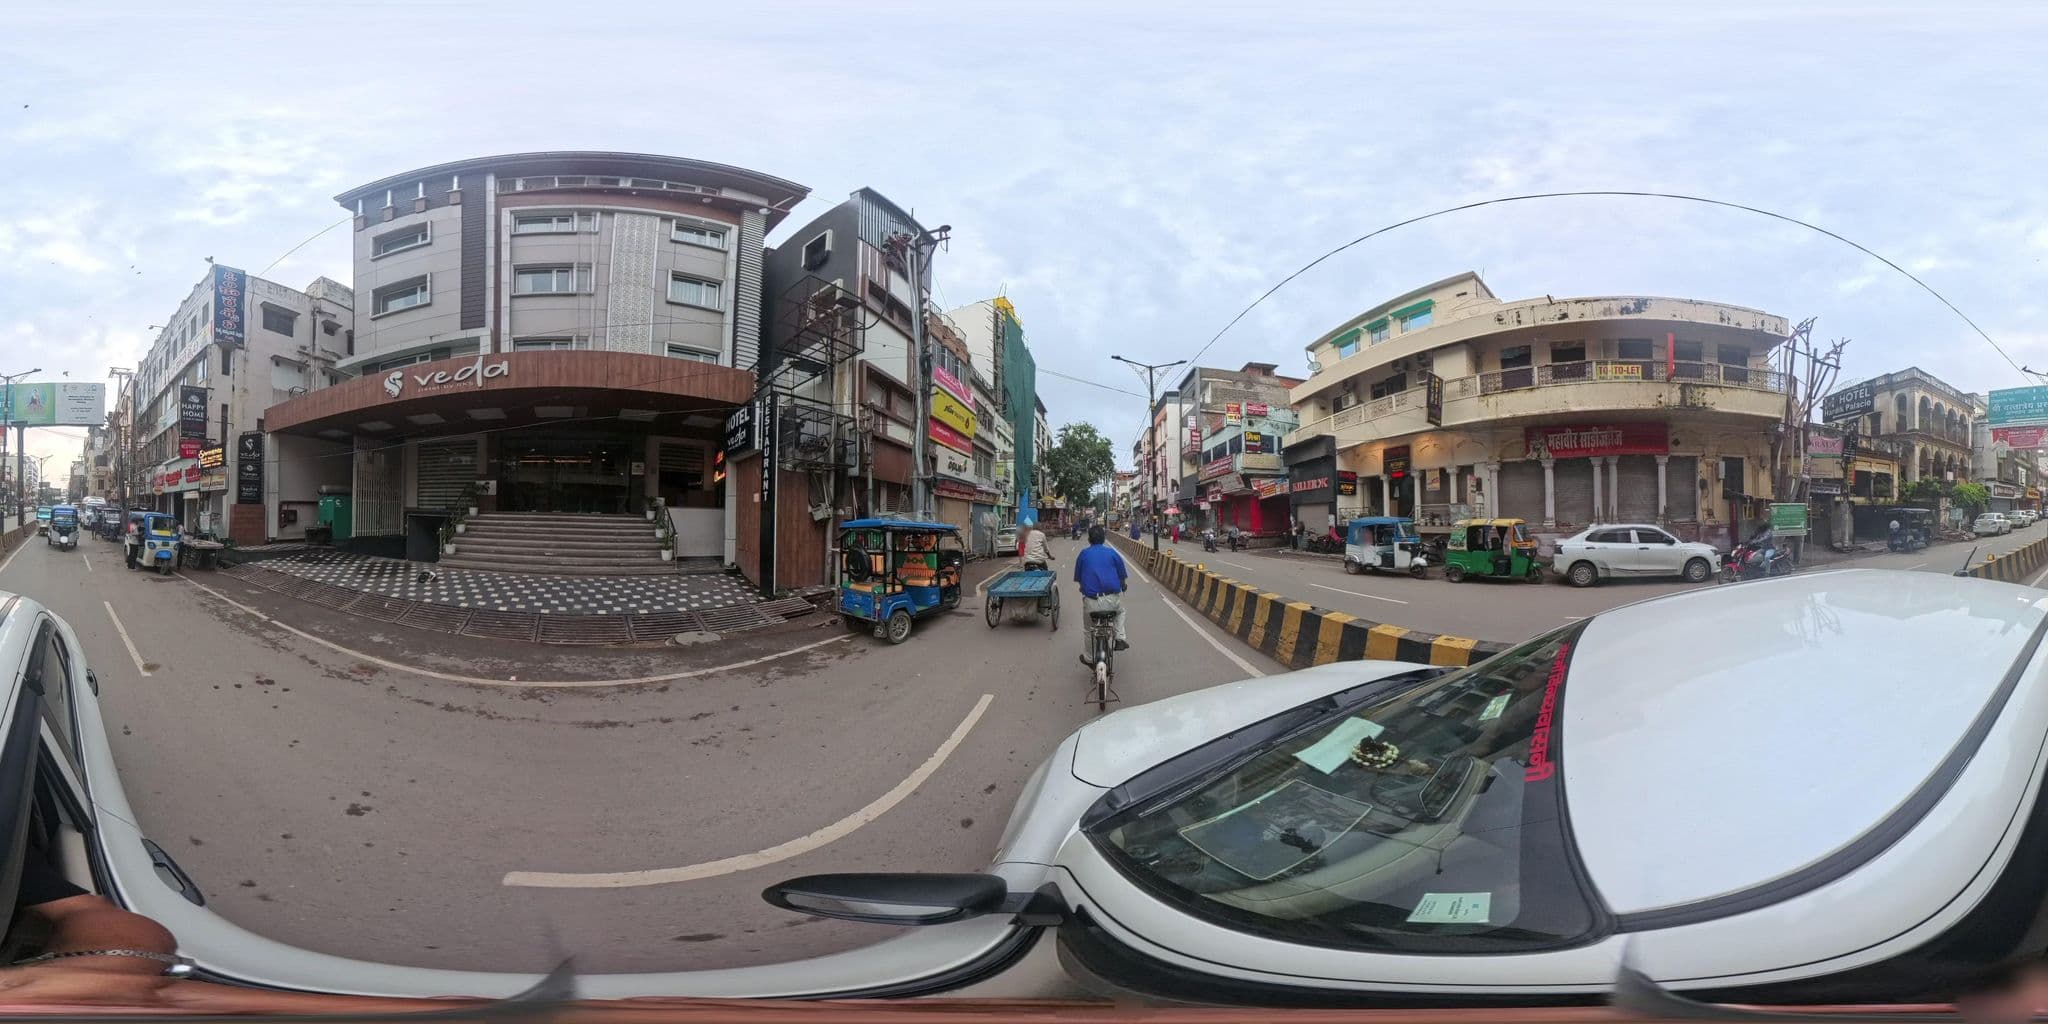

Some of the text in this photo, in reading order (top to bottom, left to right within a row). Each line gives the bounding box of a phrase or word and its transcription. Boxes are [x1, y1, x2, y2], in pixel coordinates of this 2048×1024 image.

[413, 355, 509, 387] veda
[1614, 366, 1640, 375] TO-LET
[1839, 387, 1871, 404] HOTEL
[182, 402, 205, 411] HAPPY
[183, 409, 204, 418] HOME
[725, 406, 750, 432] HOTEL
[762, 395, 771, 502] RESTAURANT
